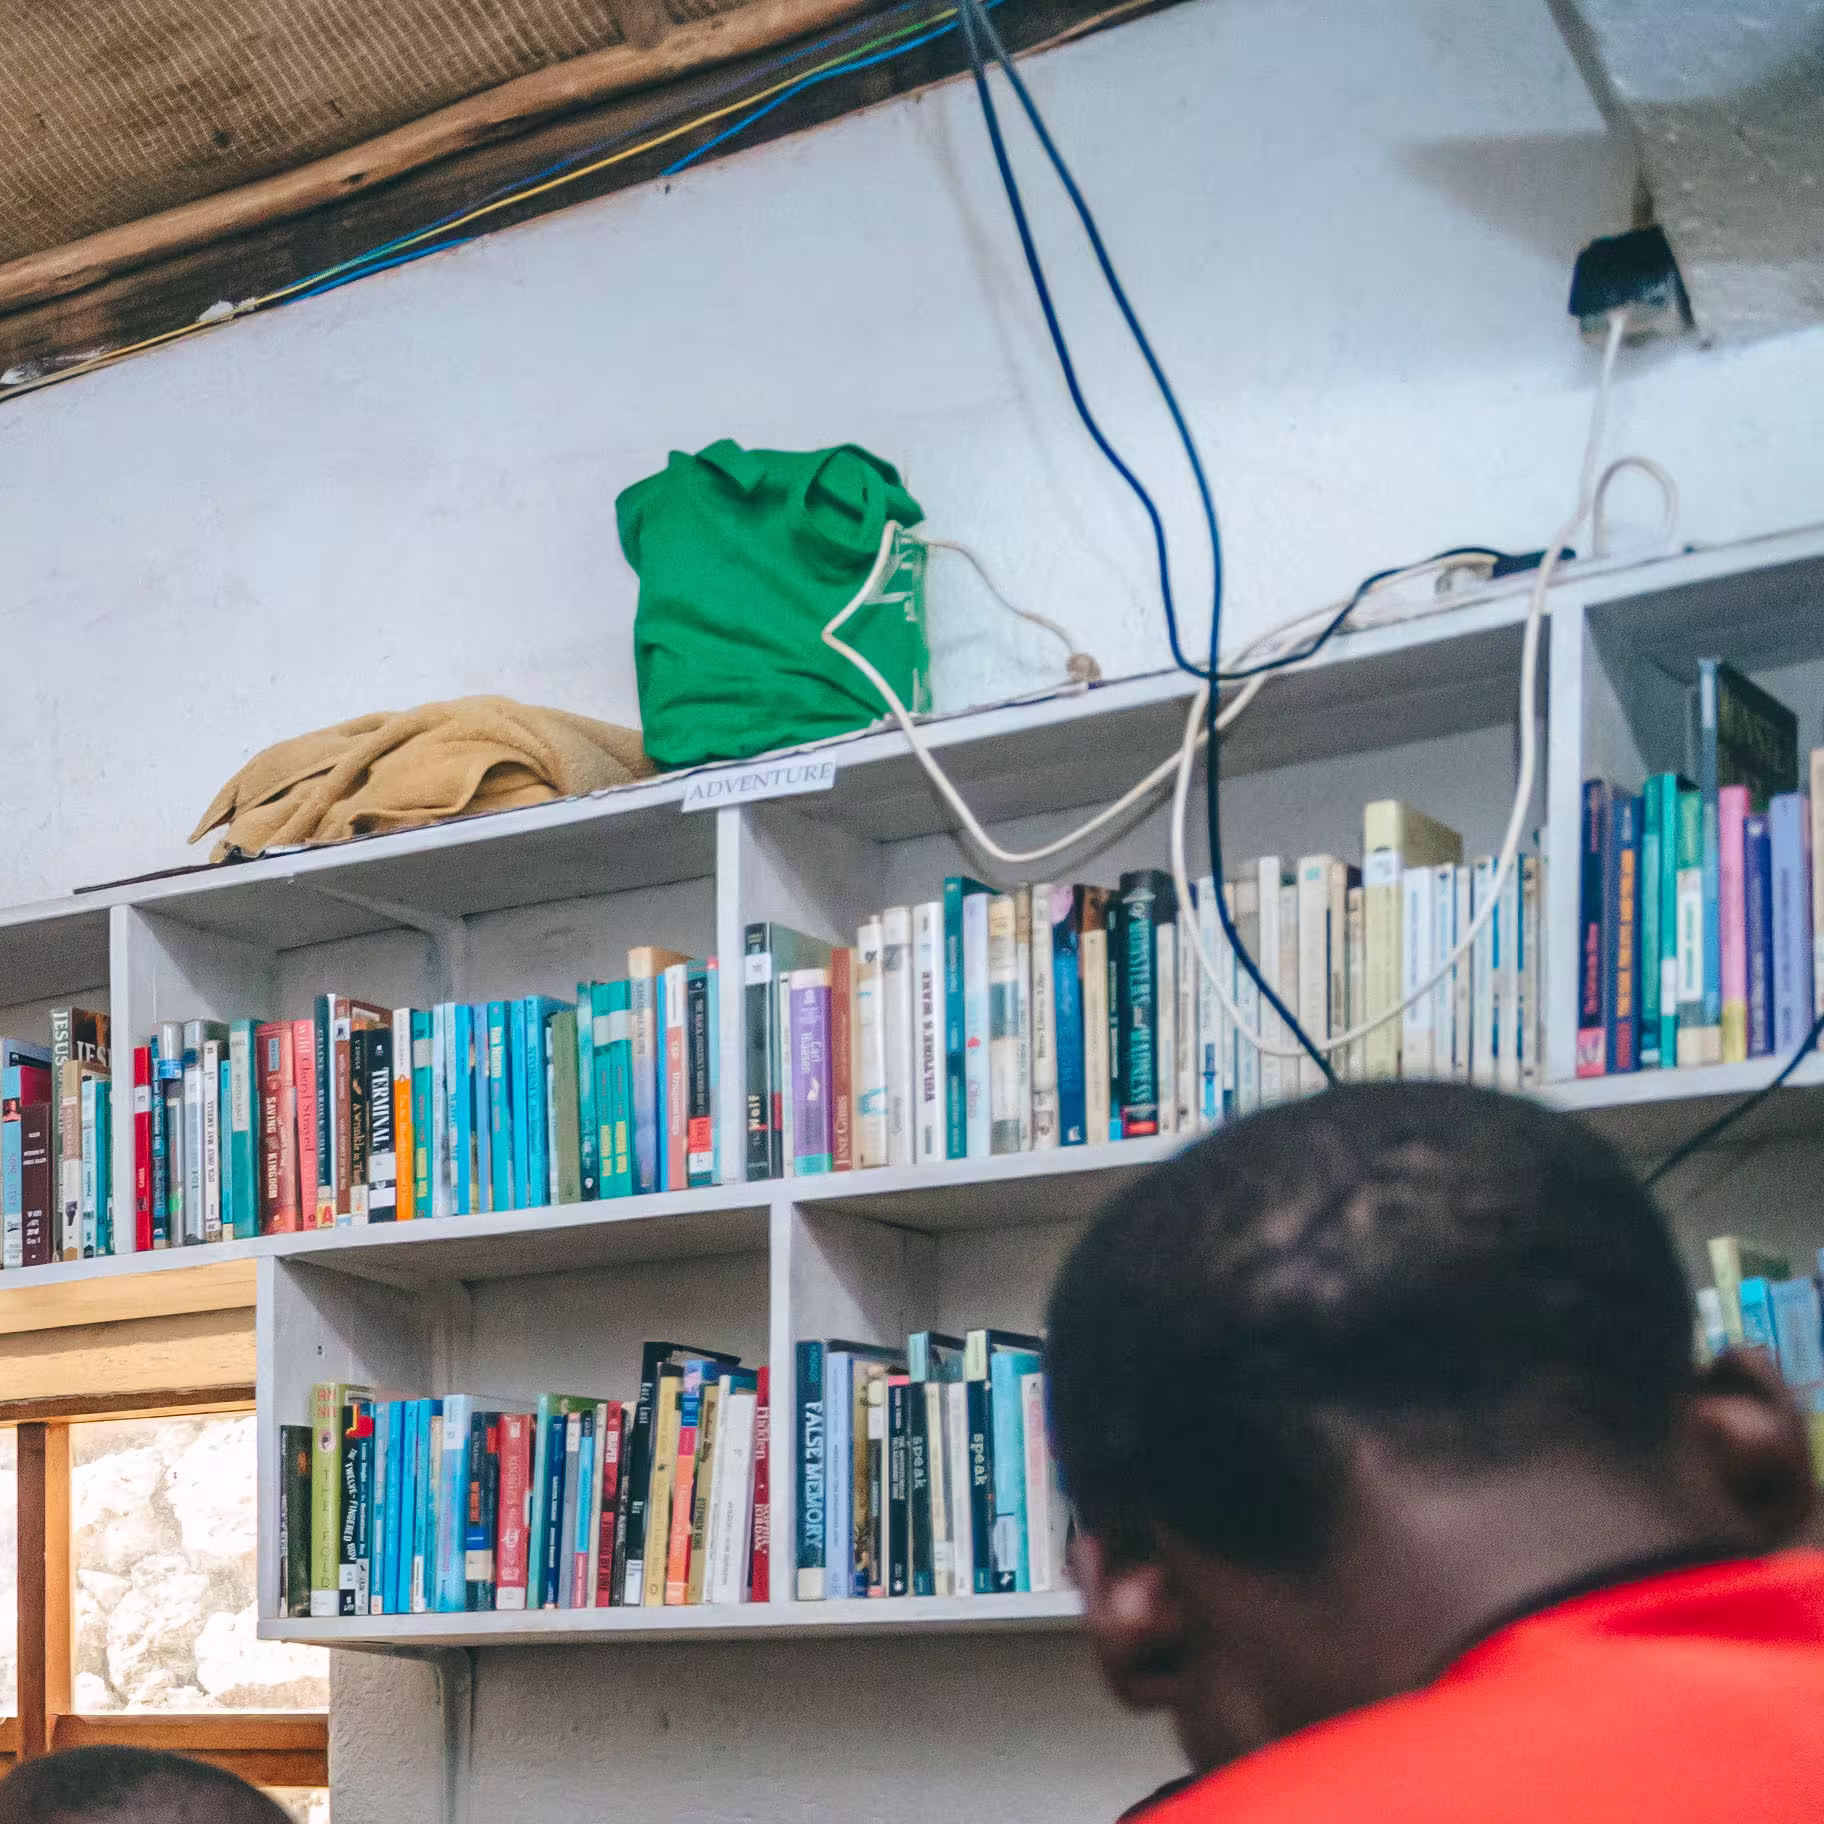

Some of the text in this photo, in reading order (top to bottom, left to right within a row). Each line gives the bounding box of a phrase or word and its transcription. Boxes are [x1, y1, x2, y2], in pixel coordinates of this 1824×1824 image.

[689, 761, 833, 802] ADVENTURE
[54, 1011, 68, 1065] JESUS
[371, 1067, 389, 1147] TERMINAL
[266, 1096, 278, 1199] SAVING KINGDOM
[805, 1400, 824, 1548] FALSE MEMORY
[912, 1436, 926, 1489] speak
[972, 1433, 987, 1486] speak
